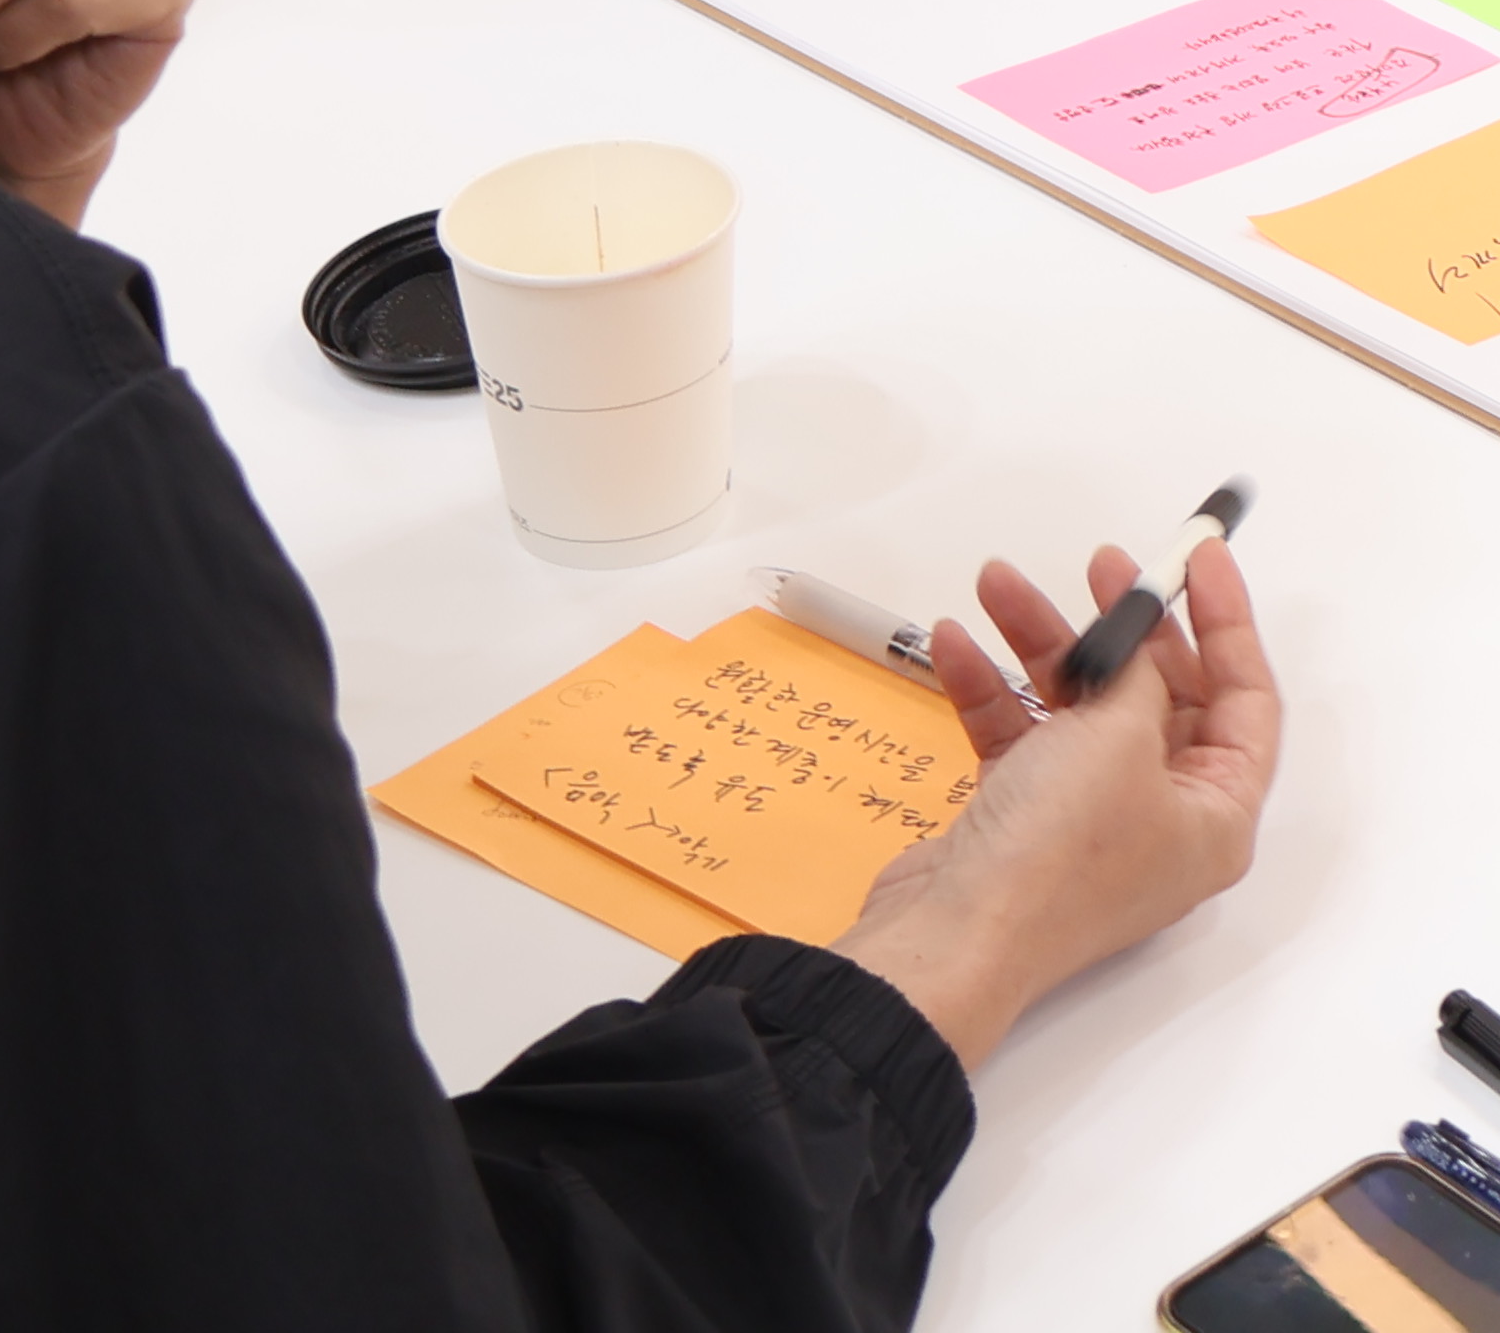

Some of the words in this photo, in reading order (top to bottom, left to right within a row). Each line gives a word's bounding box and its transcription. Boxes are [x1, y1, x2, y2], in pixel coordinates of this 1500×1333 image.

[623, 724, 707, 790] 받도록
[714, 774, 776, 813] 유도
[672, 696, 761, 747] 다양한
[766, 737, 847, 793] 계층이
[704, 660, 800, 712] 원활한
[796, 702, 859, 742] 운영
[856, 728, 936, 783] 시간을
